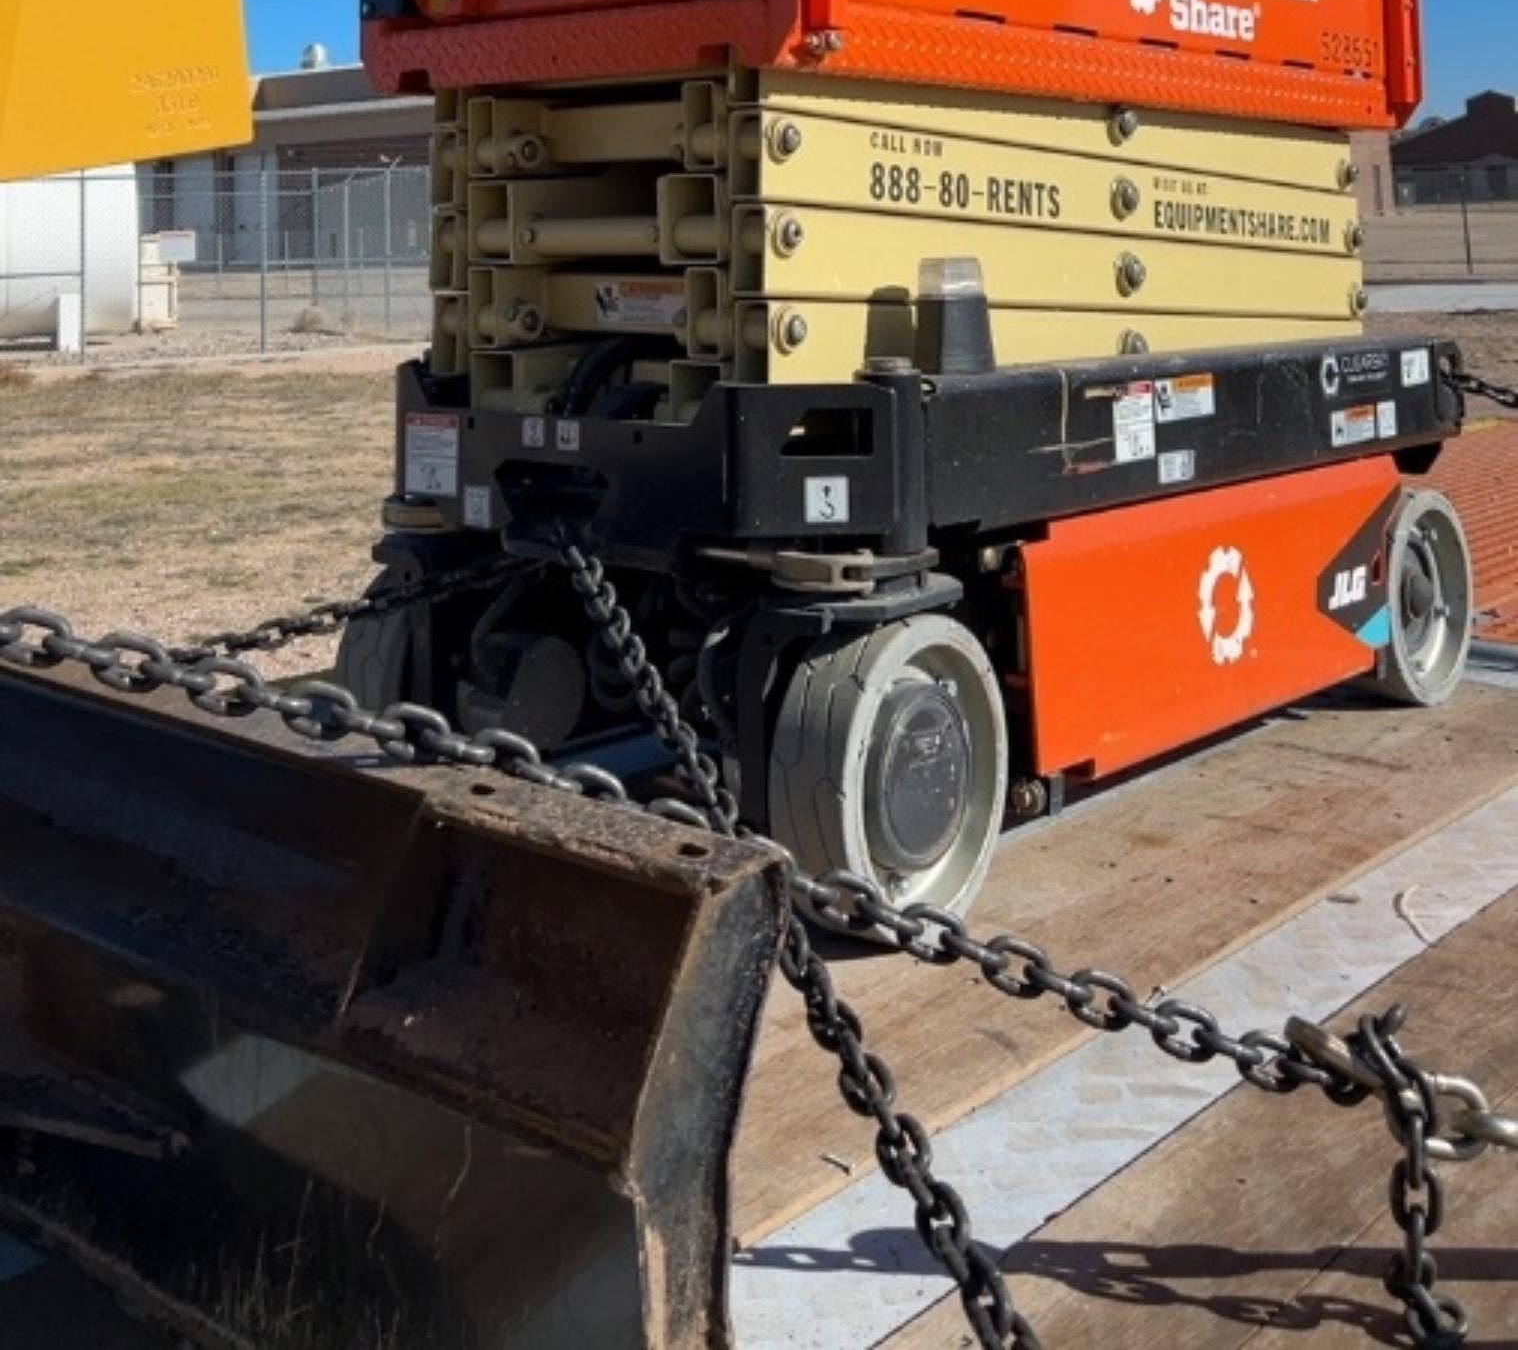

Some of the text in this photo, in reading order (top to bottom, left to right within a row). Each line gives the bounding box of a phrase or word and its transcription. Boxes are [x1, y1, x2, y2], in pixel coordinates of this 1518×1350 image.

[869, 131, 944, 157] CALL NOW
[869, 161, 1062, 219] 888-80-RENTS
[1153, 200, 1331, 244] EQUIPMENTSHARE.COM
[1327, 563, 1367, 611] JLG
